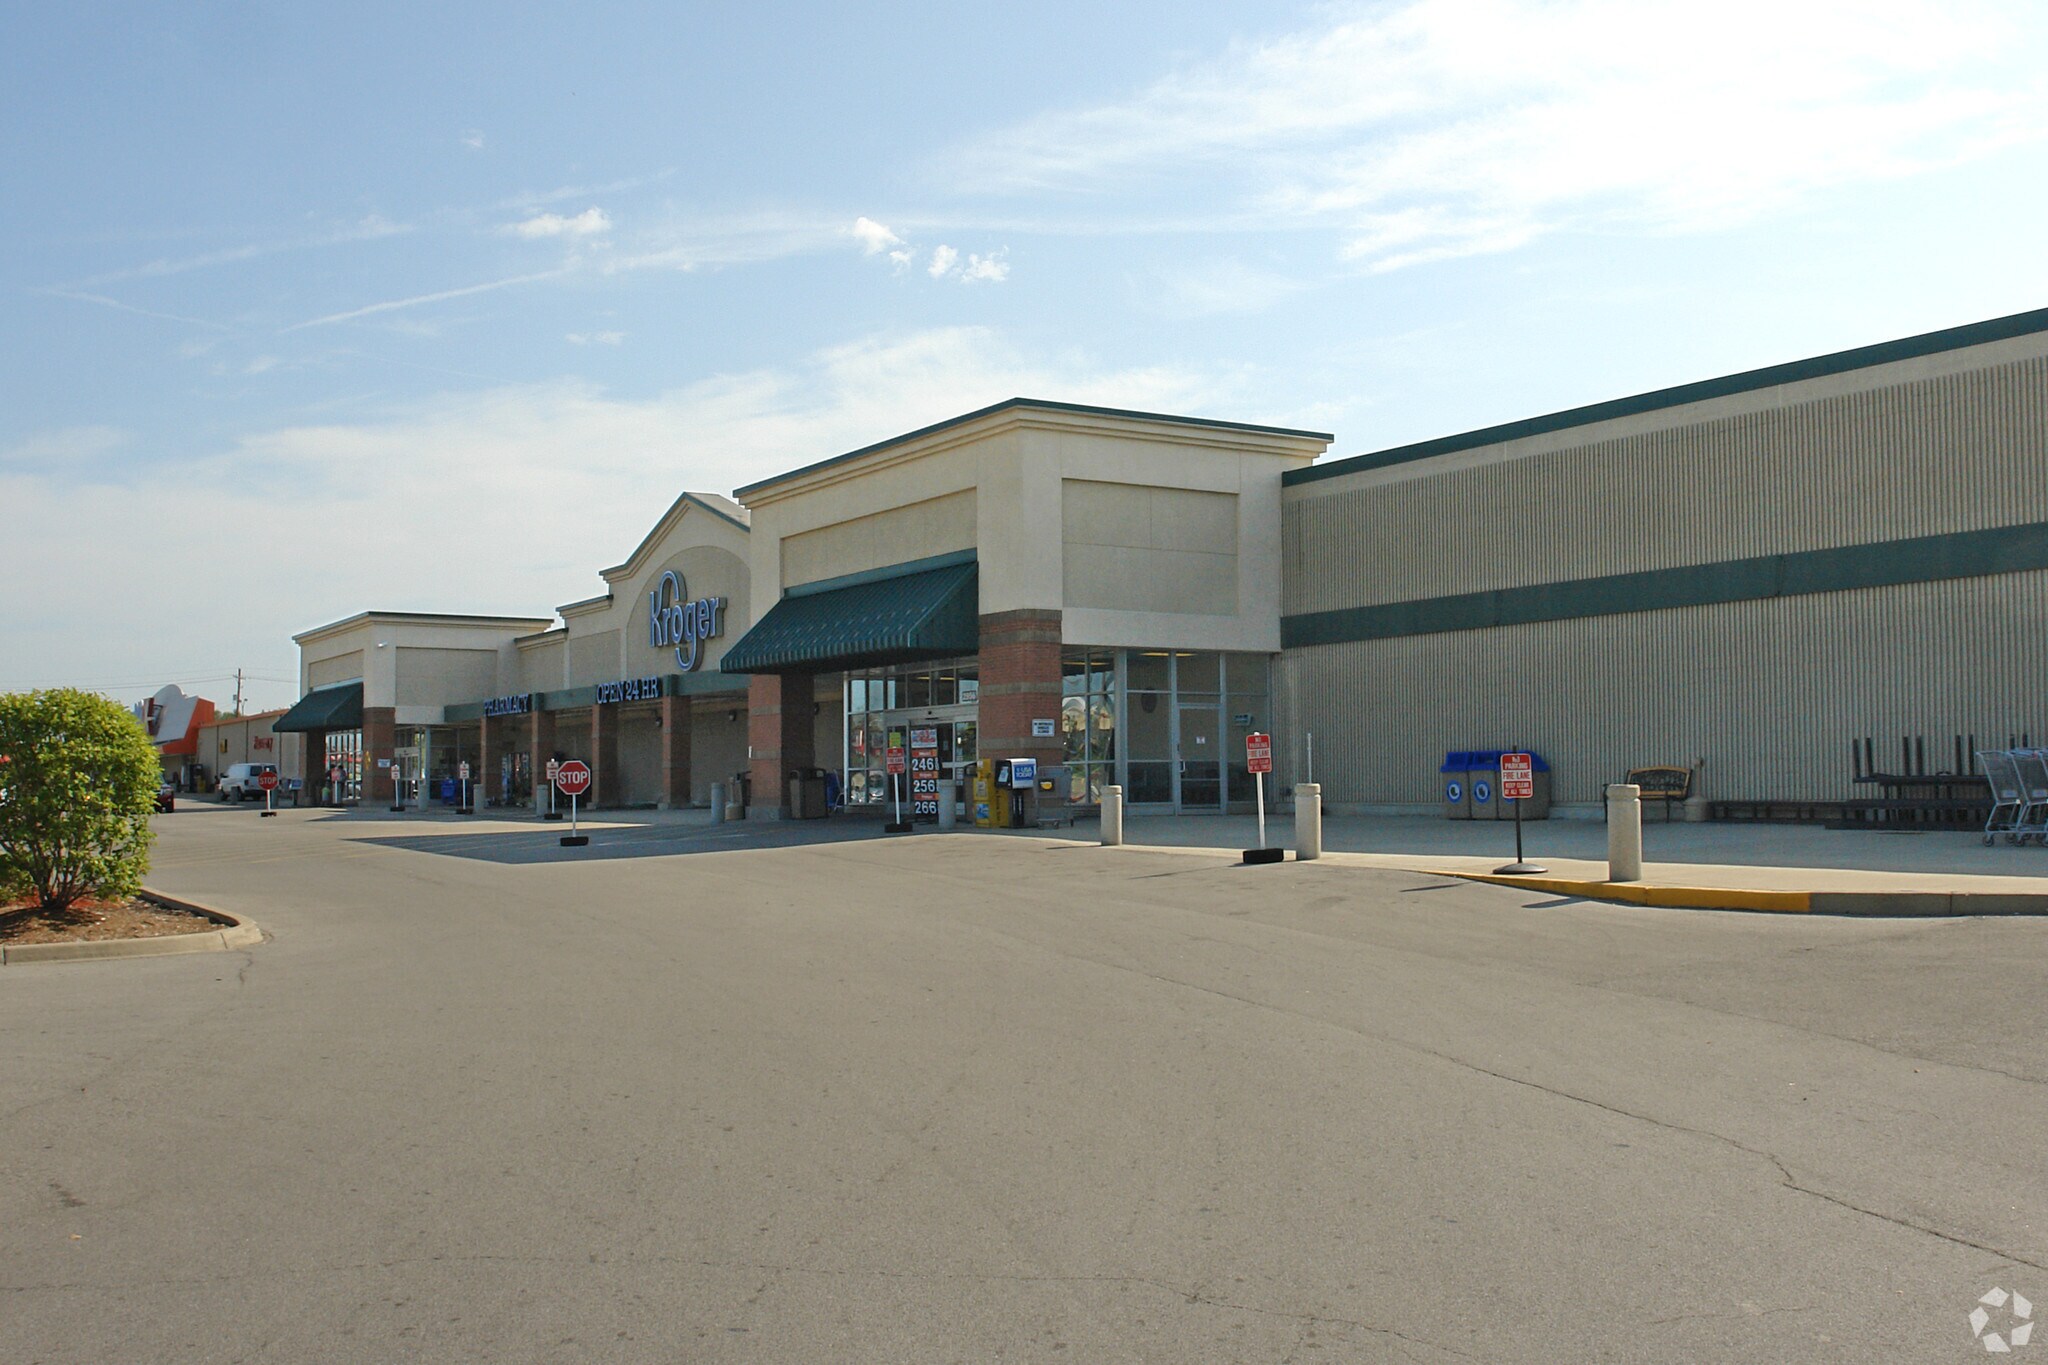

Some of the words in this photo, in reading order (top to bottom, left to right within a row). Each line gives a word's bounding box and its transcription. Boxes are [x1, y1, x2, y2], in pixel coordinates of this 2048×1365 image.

[650, 570, 721, 671] Kroger
[597, 681, 623, 704] OPEN
[625, 680, 639, 701] 24
[641, 676, 659, 699] HR
[484, 694, 529, 716] PHARMACY
[260, 776, 277, 785] STOP
[559, 771, 588, 784] STOP
[1503, 771, 1515, 779] FIRE
[1516, 771, 1530, 779] LANE
[915, 801, 937, 814] 266
